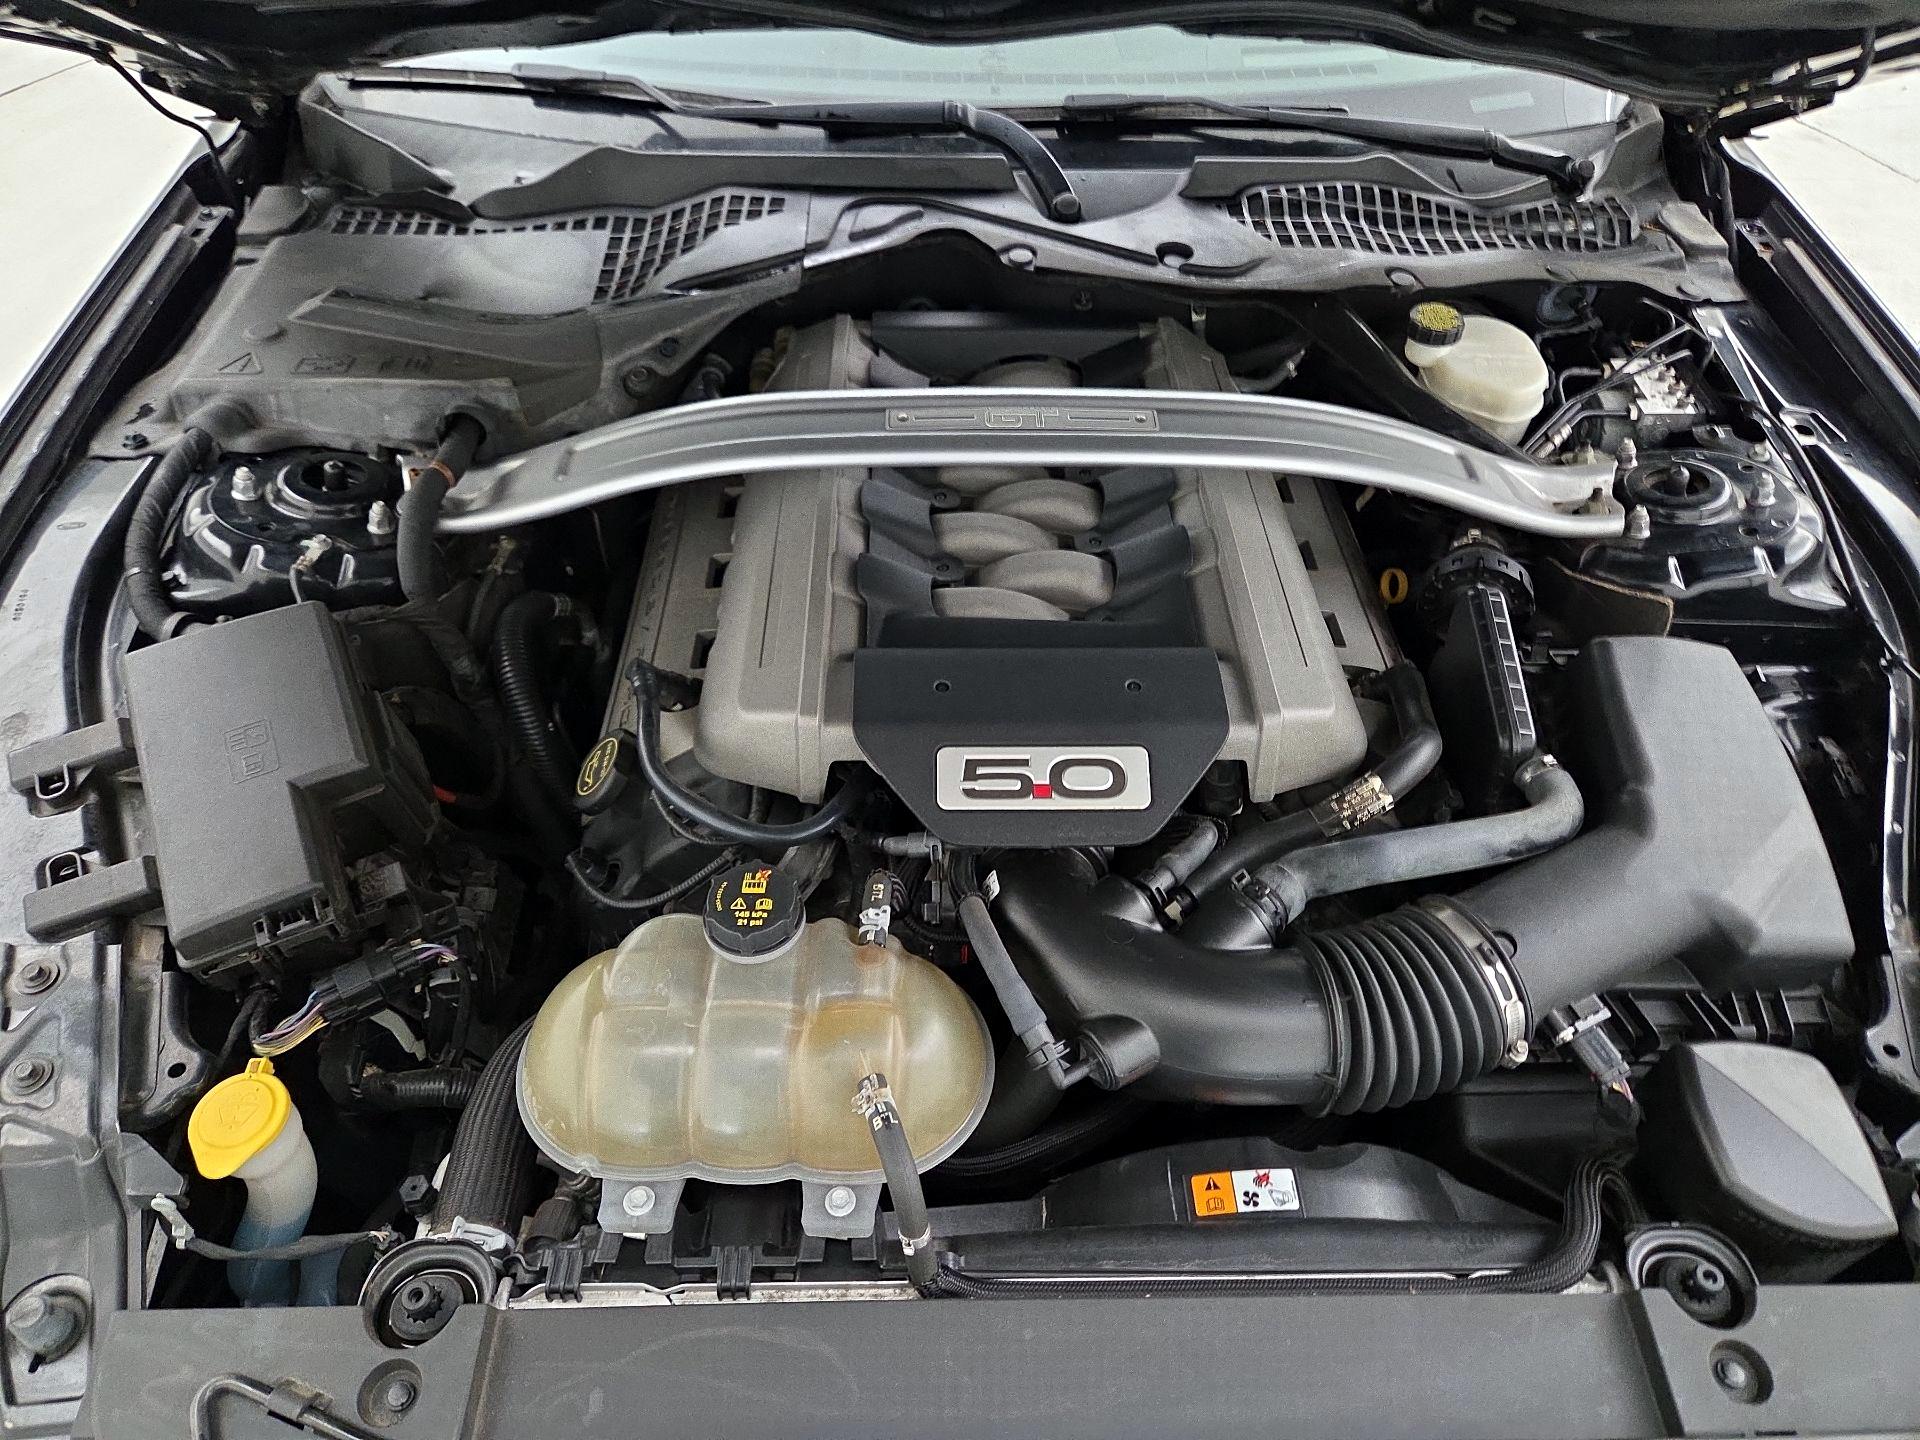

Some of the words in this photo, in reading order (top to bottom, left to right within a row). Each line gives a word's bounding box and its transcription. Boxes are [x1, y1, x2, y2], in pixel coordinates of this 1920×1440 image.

[984, 405, 1060, 428] GT
[960, 755, 1128, 800] 5.0
[749, 919, 763, 927] psi
